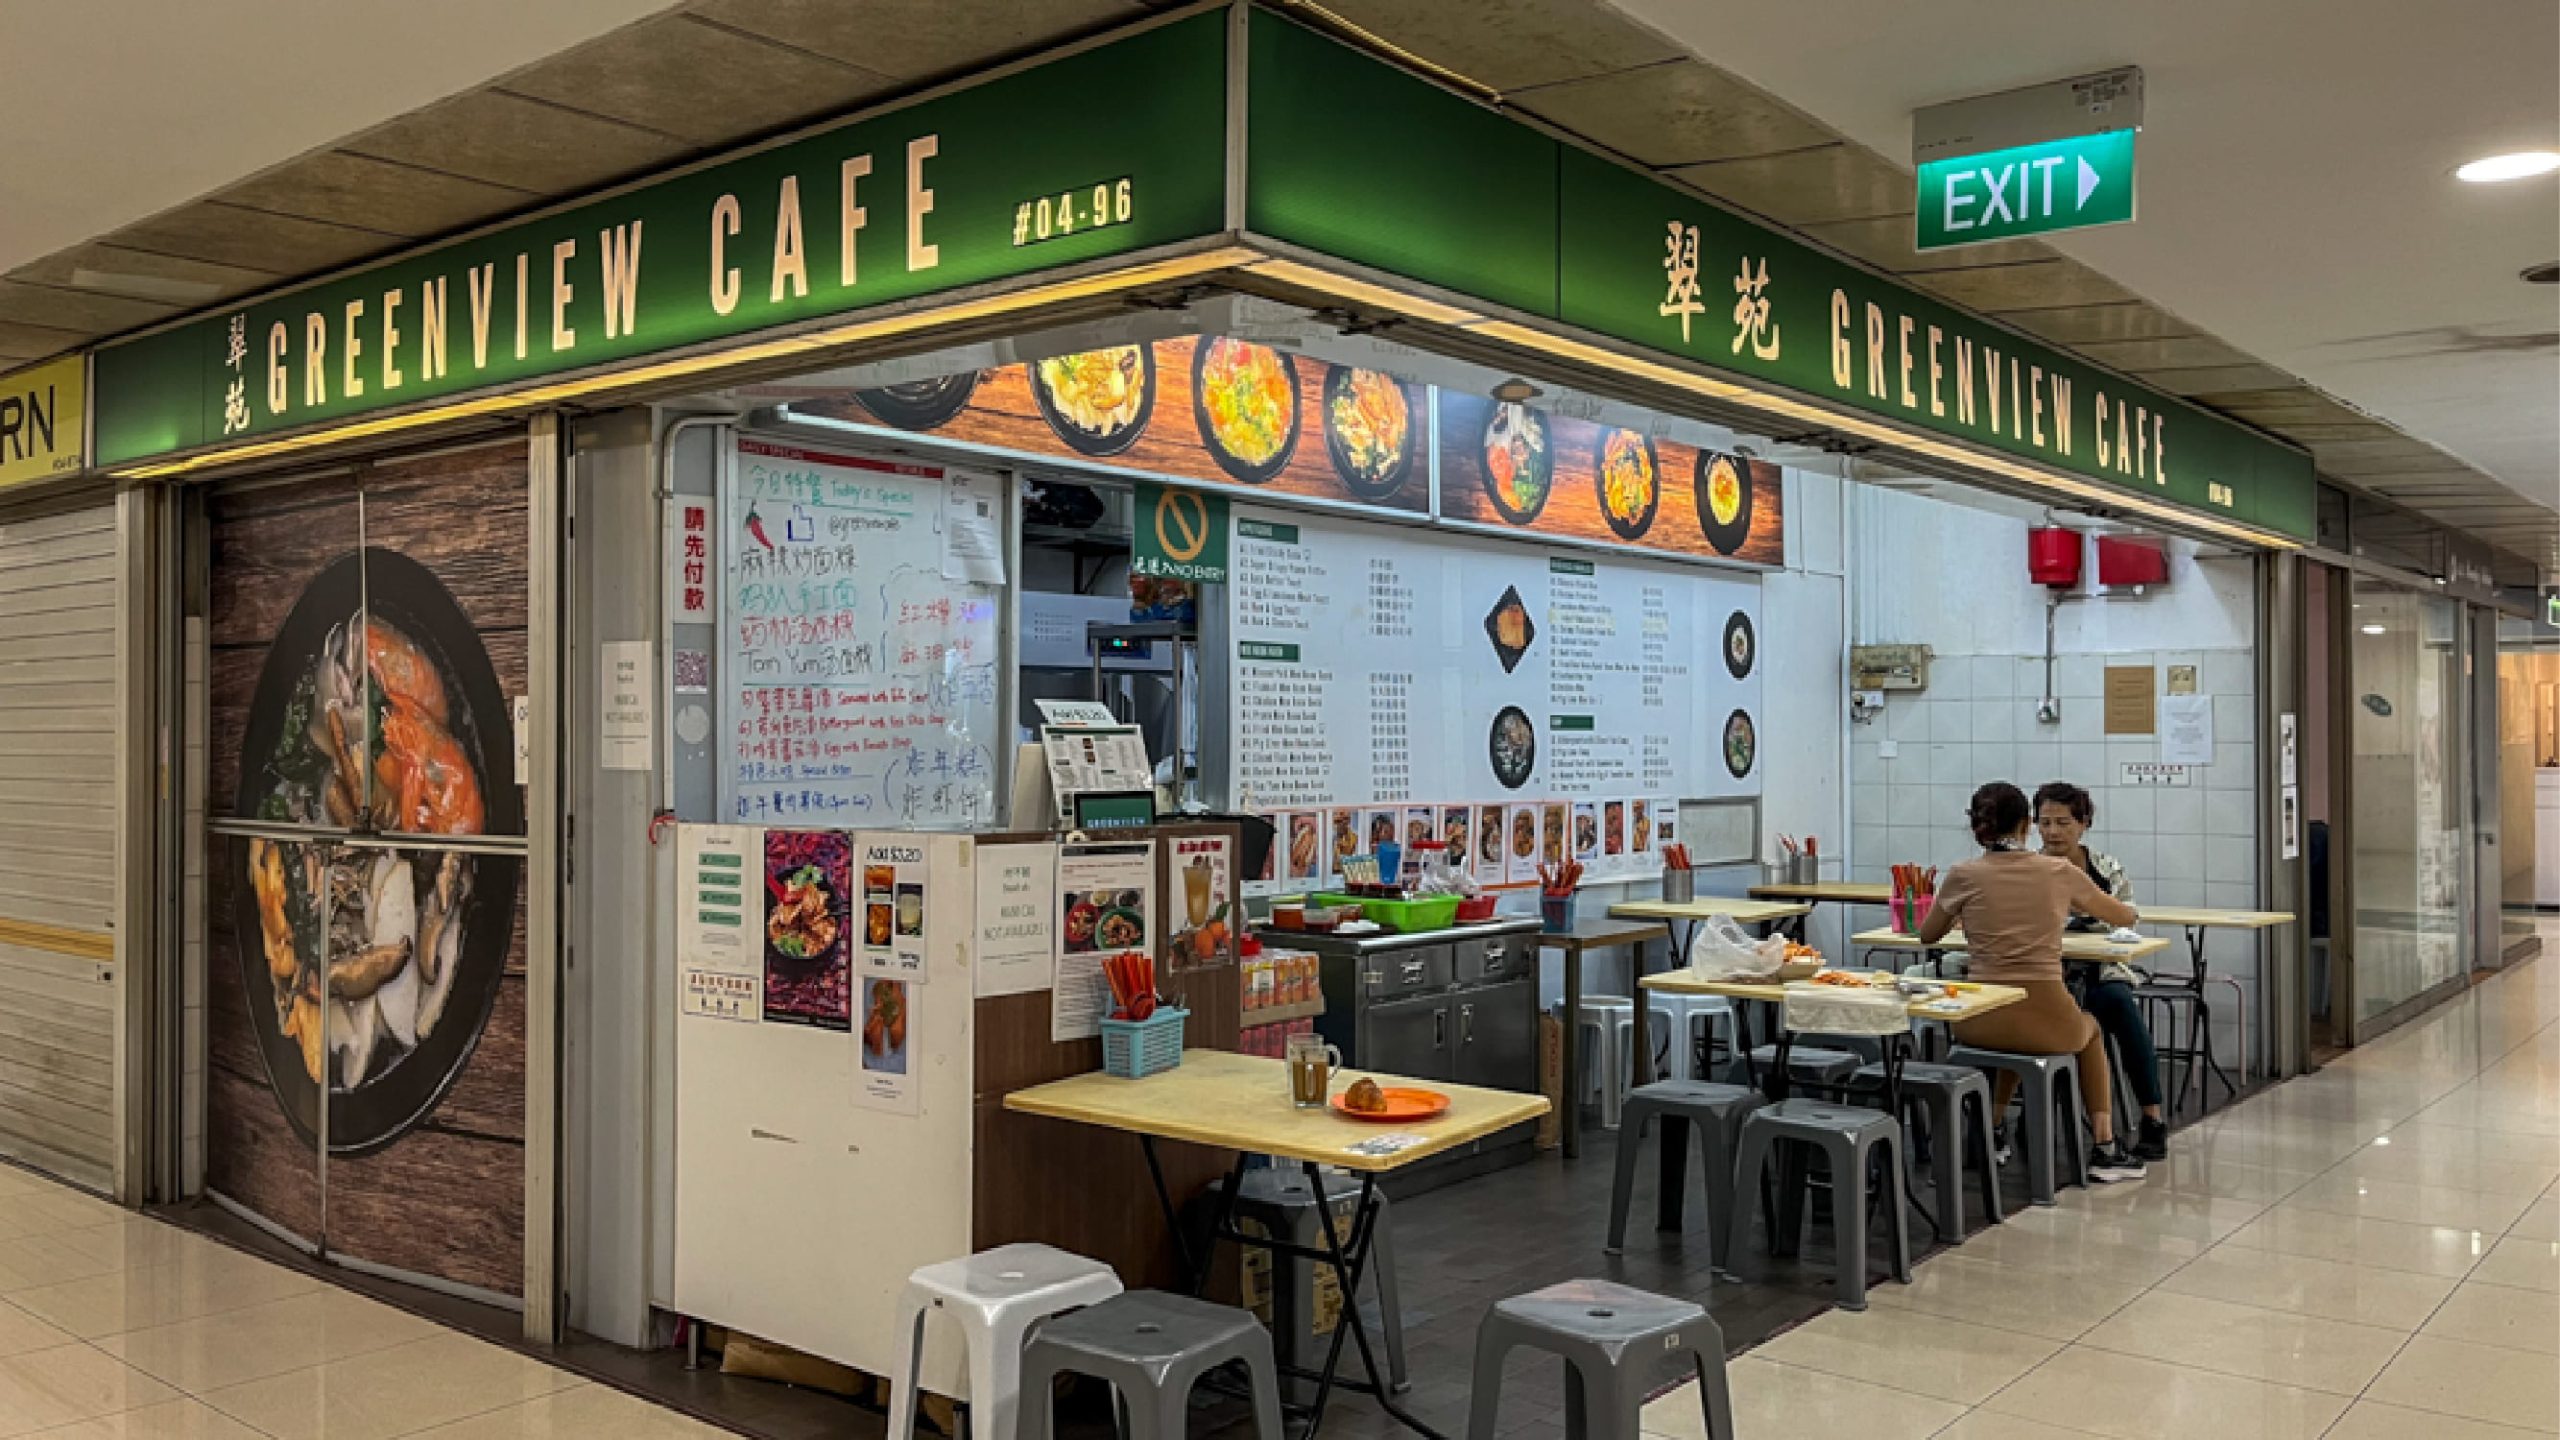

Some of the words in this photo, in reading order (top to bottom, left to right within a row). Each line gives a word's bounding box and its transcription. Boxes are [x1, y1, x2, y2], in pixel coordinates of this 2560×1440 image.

[1943, 155, 2065, 232] EXIT
[267, 219, 643, 416] GREENVIEW
[710, 133, 939, 316] CAFE
[1659, 219, 1780, 361] 翠苑
[1830, 287, 2071, 457] GREENVIEW
[2095, 390, 2167, 486] CAFE
[684, 506, 705, 611] 請先付款
